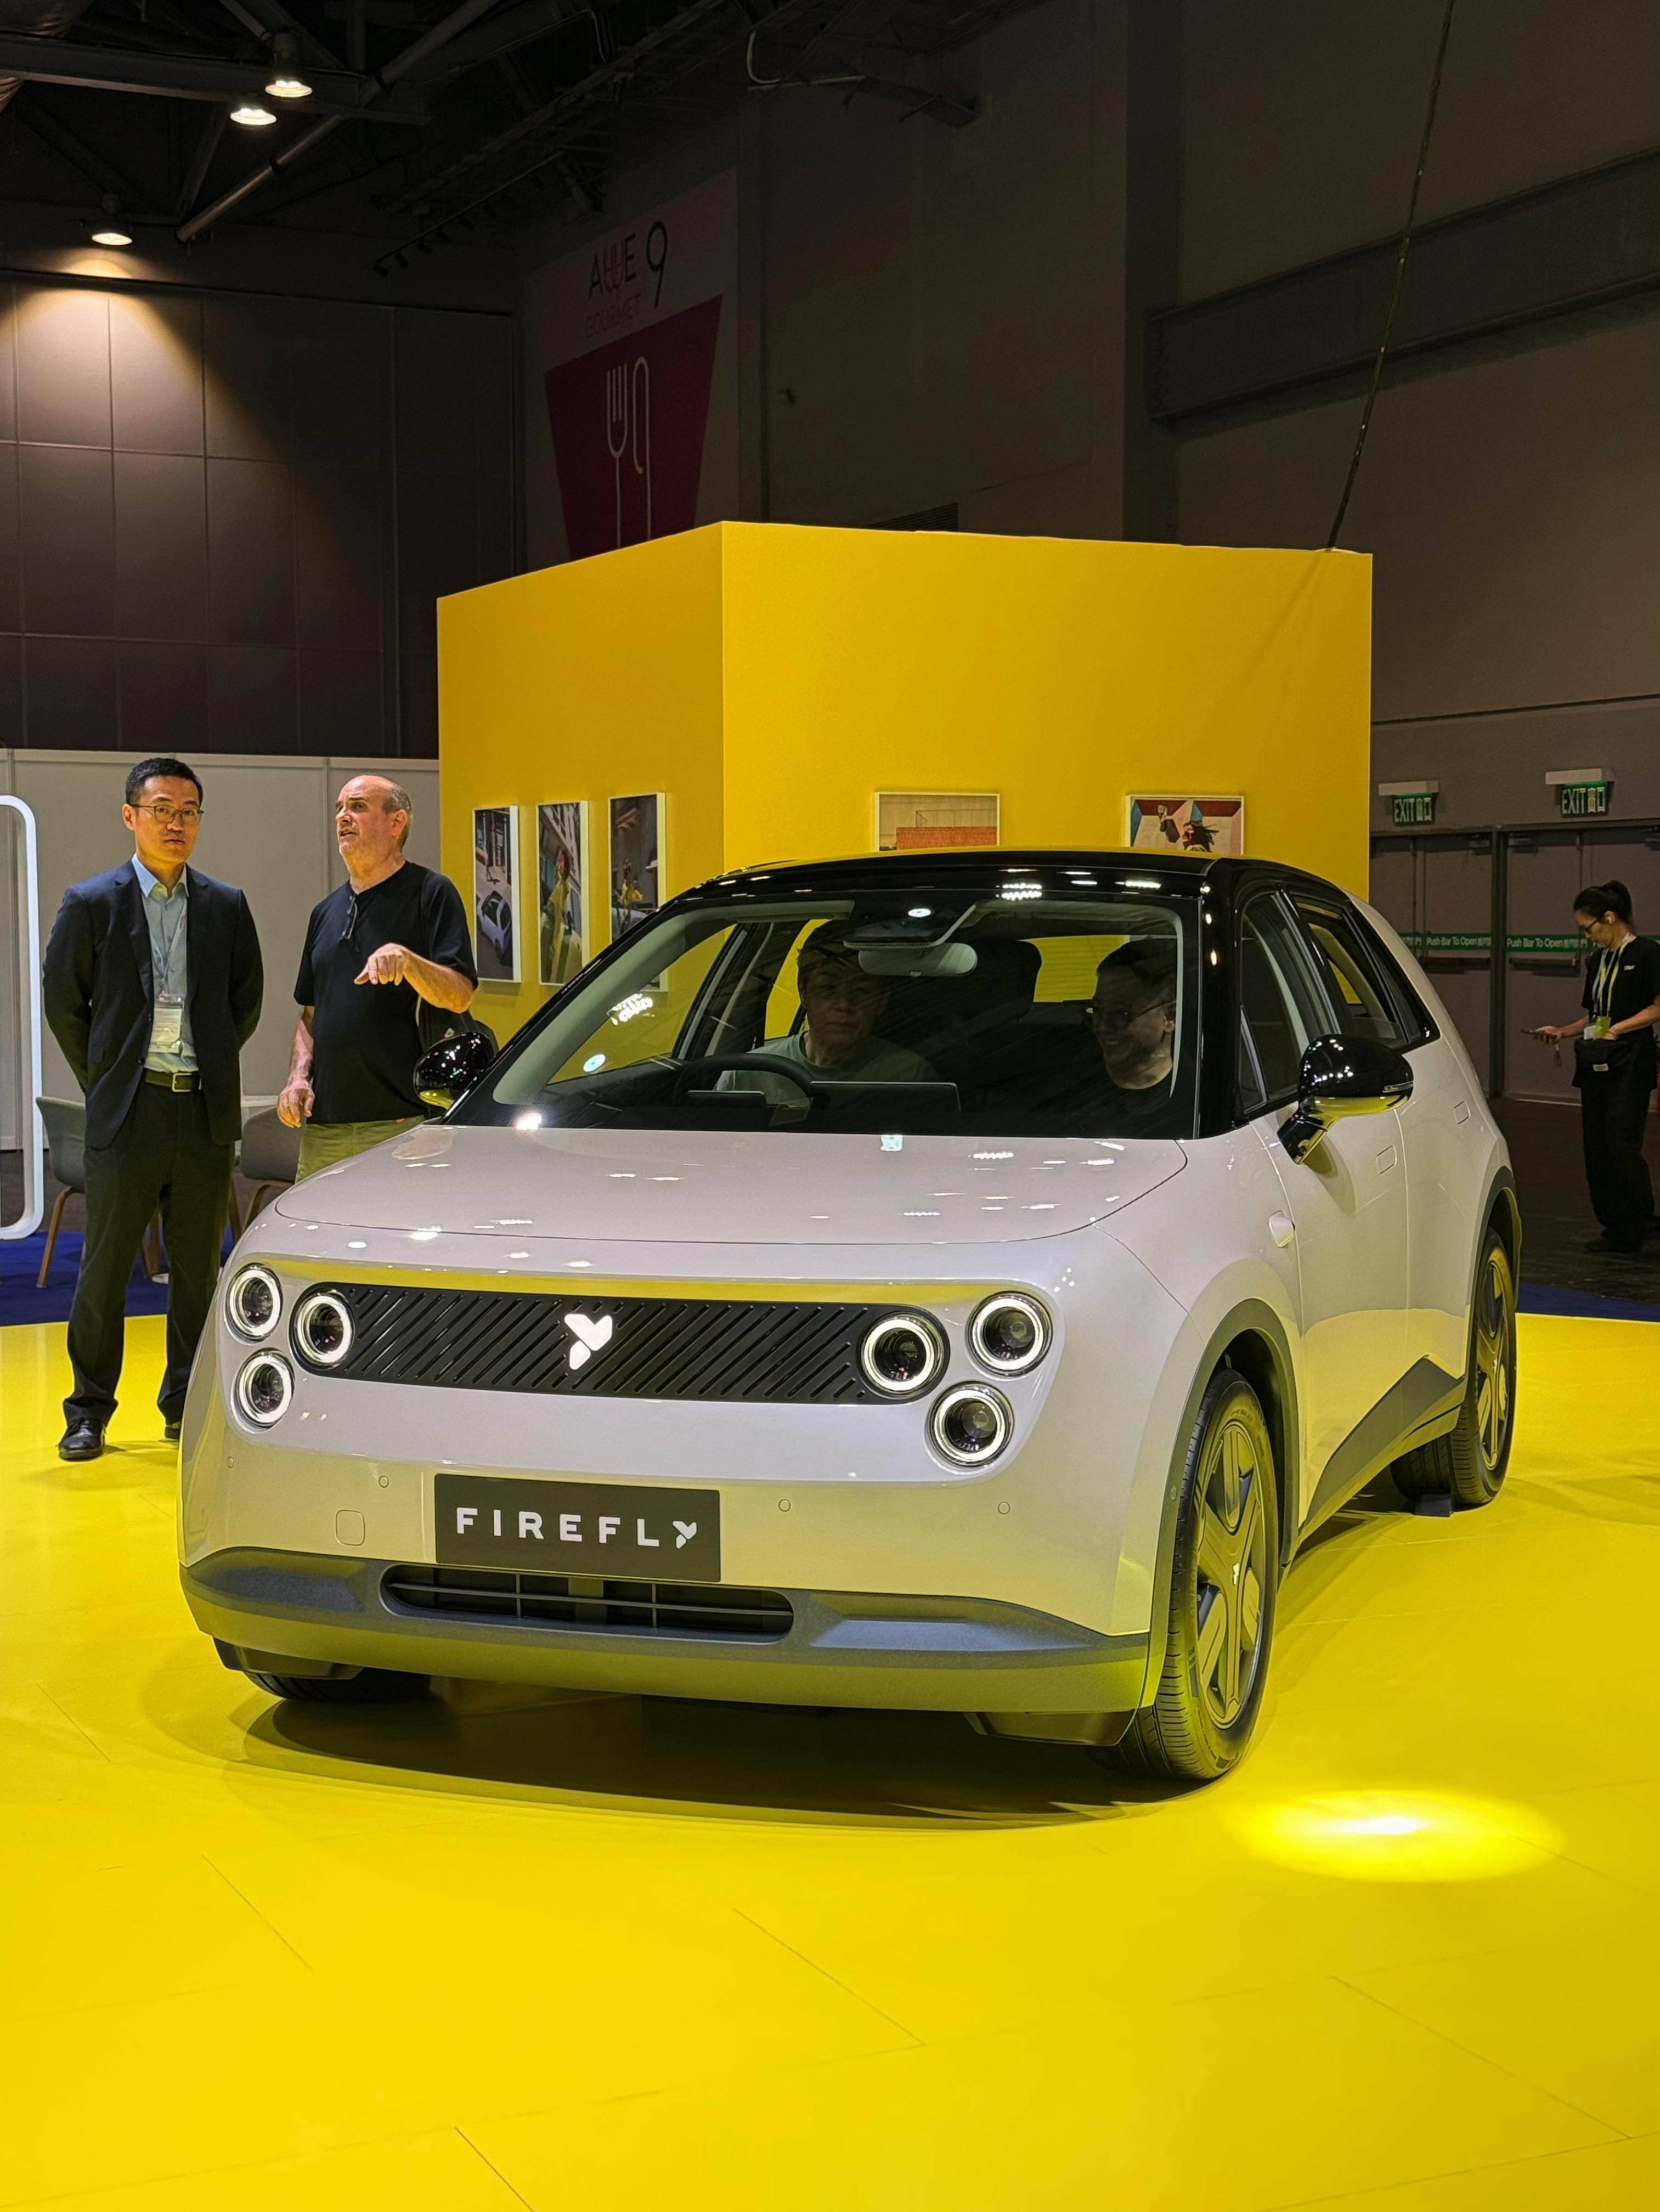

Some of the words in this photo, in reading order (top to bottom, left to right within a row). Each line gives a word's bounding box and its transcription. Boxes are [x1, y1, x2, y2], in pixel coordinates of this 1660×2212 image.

[646, 221, 668, 308] 9
[1394, 798, 1415, 822] EXIT
[1562, 788, 1585, 814] EXIT
[1426, 936, 1441, 946] Push
[1441, 936, 1452, 946] Bar
[1452, 936, 1460, 946] To
[1460, 936, 1477, 947] Open
[1506, 938, 1522, 948] Push
[1523, 938, 1534, 948] Bar
[1535, 938, 1543, 948] To
[1544, 938, 1563, 949] Open
[456, 1506, 698, 1549] FIREFLY
